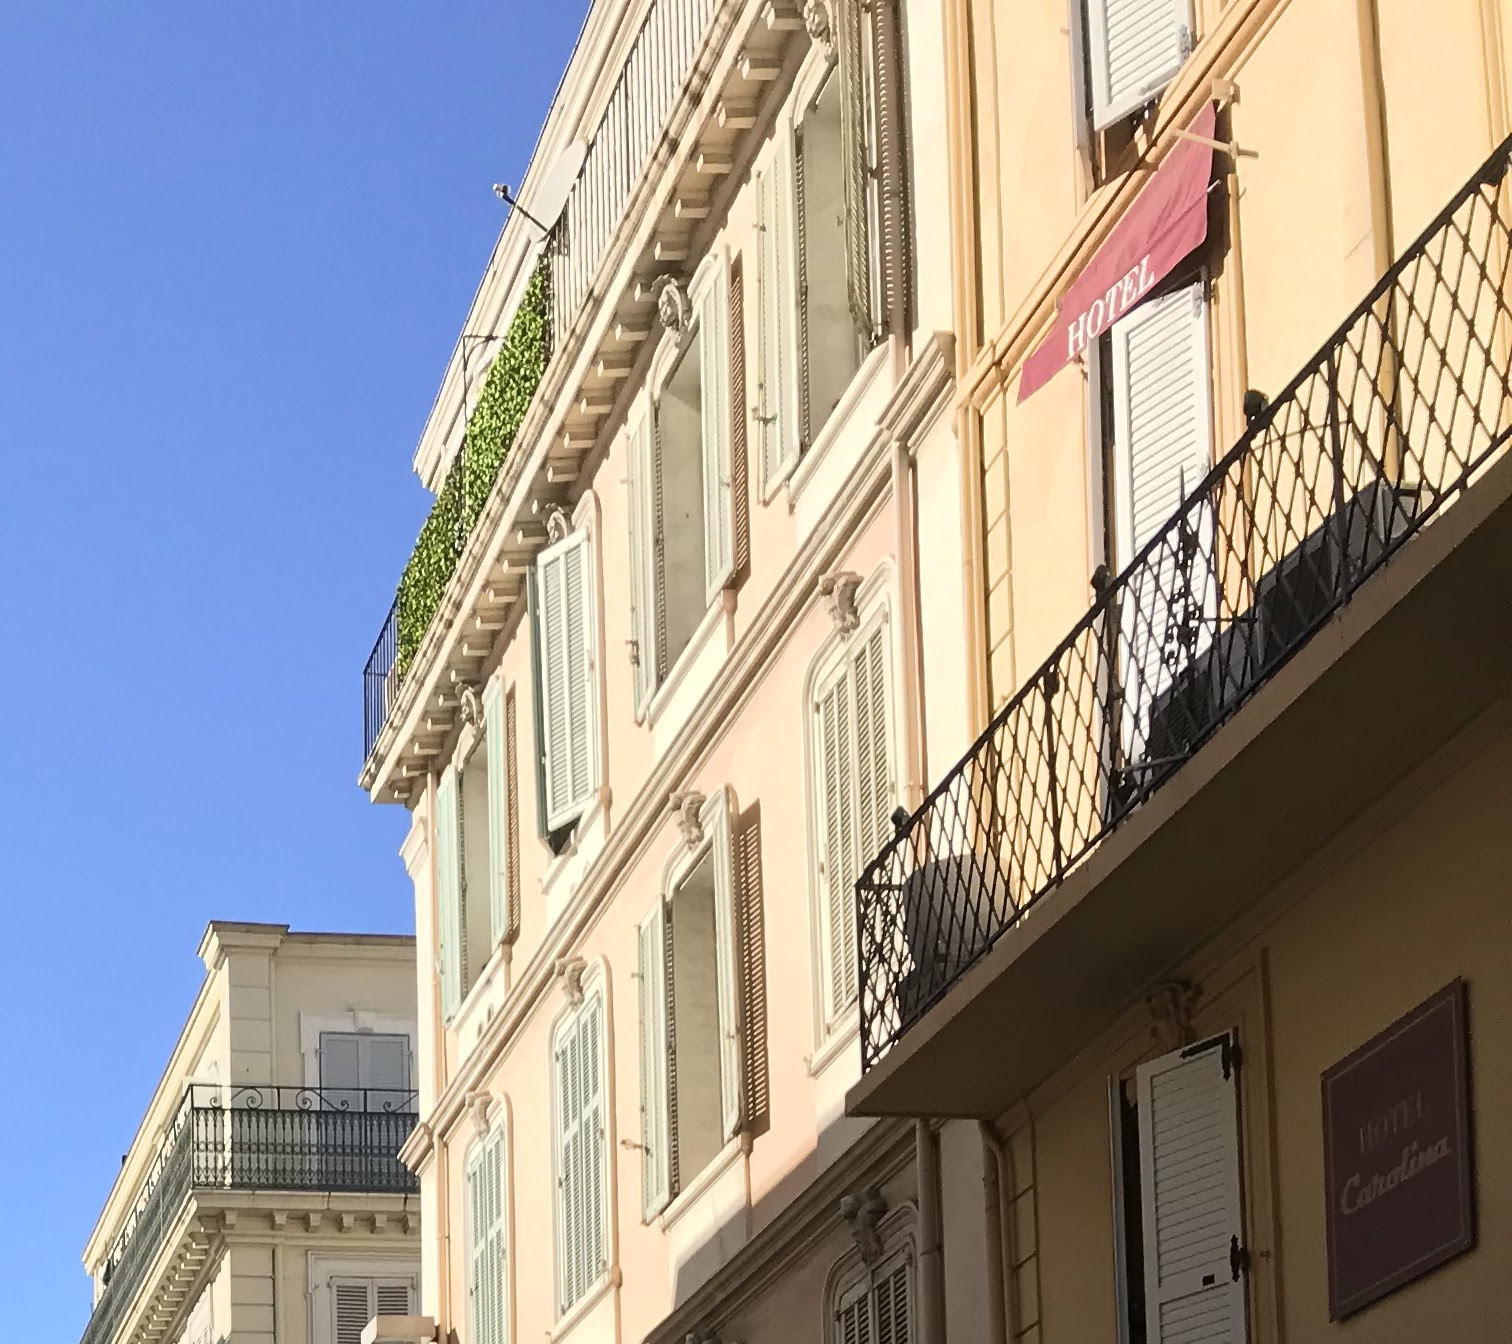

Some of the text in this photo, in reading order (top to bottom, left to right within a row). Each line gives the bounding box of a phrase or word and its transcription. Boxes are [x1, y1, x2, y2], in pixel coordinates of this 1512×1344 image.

[1067, 254, 1155, 360] HOTEL
[1359, 1090, 1430, 1156] HOTEL
[1340, 1135, 1453, 1216] Carolina
